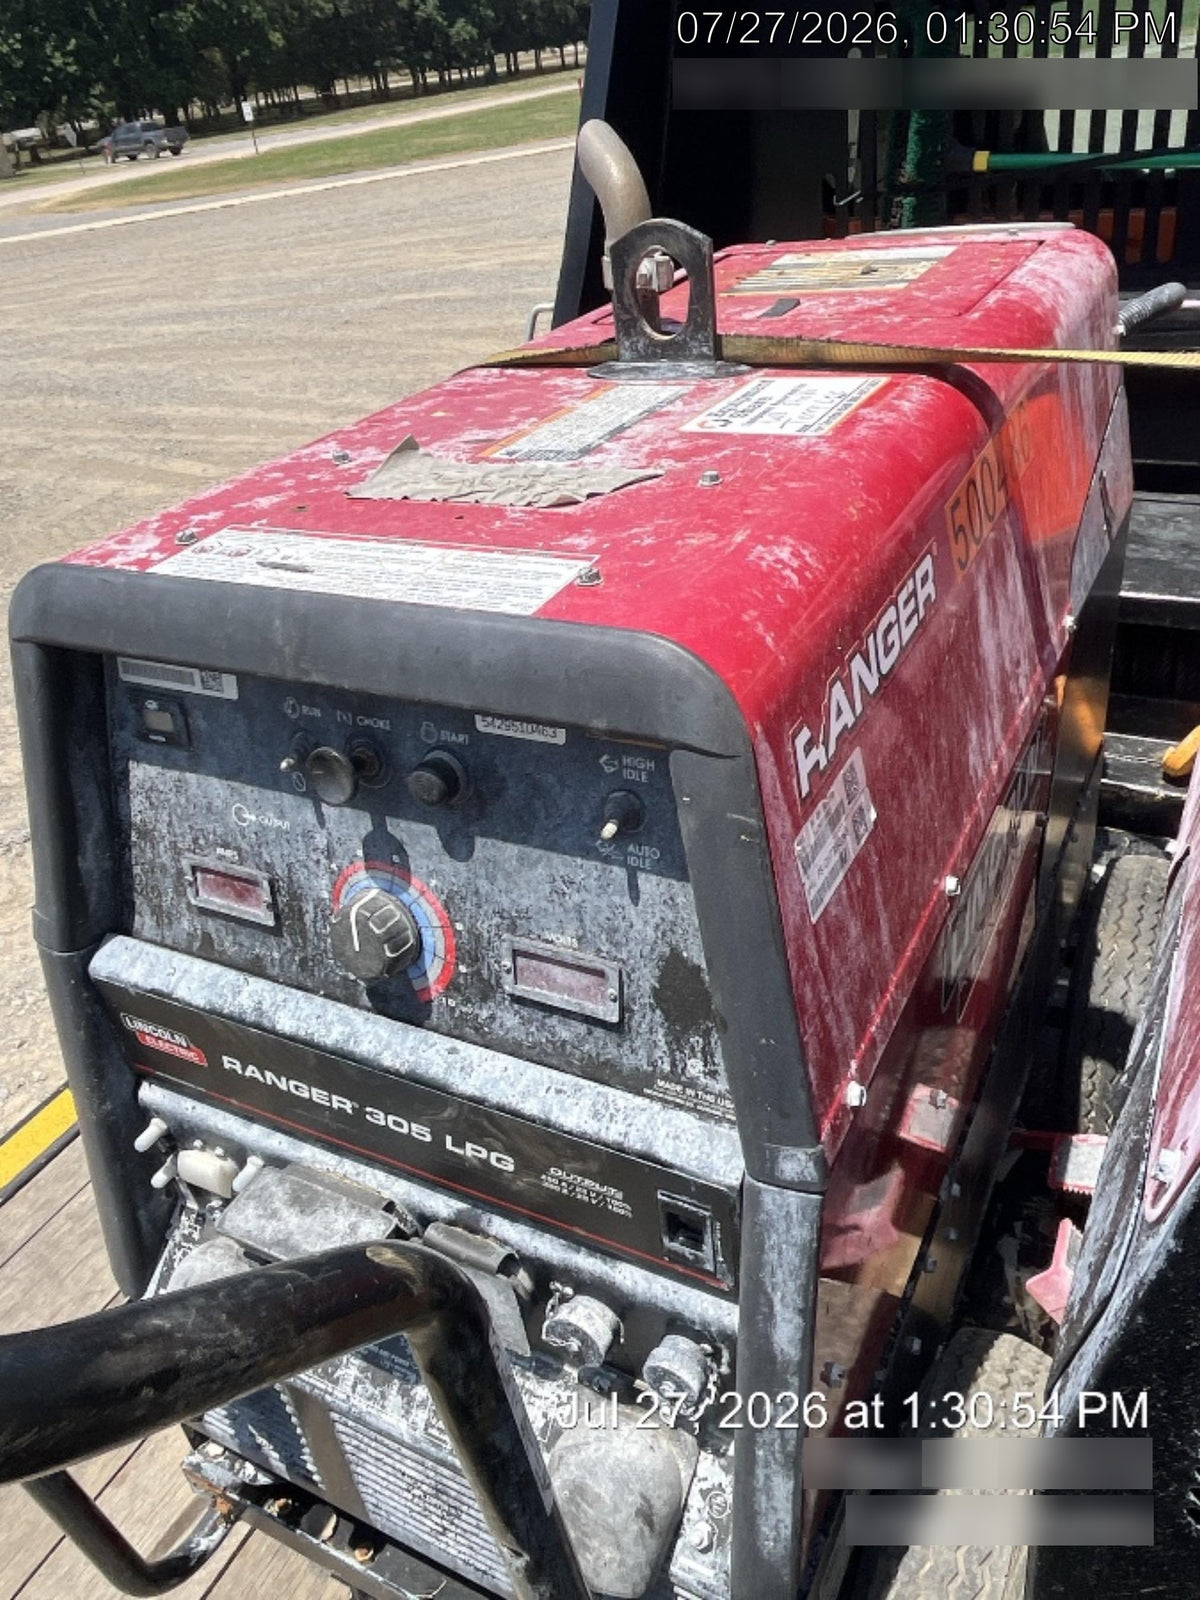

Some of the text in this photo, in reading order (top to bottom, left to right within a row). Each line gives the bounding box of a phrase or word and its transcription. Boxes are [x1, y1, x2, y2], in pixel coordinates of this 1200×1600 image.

[791, 552, 937, 799] RANGER
[356, 715, 391, 731] CHOKE
[440, 729, 469, 745] START
[621, 755, 655, 771] HIGH
[622, 768, 649, 783] IDLE
[627, 844, 660, 859] AUTO
[627, 855, 651, 869] IDLE
[125, 1015, 189, 1049] LINCOLN
[221, 1055, 515, 1173] RANGER 305 LPG
